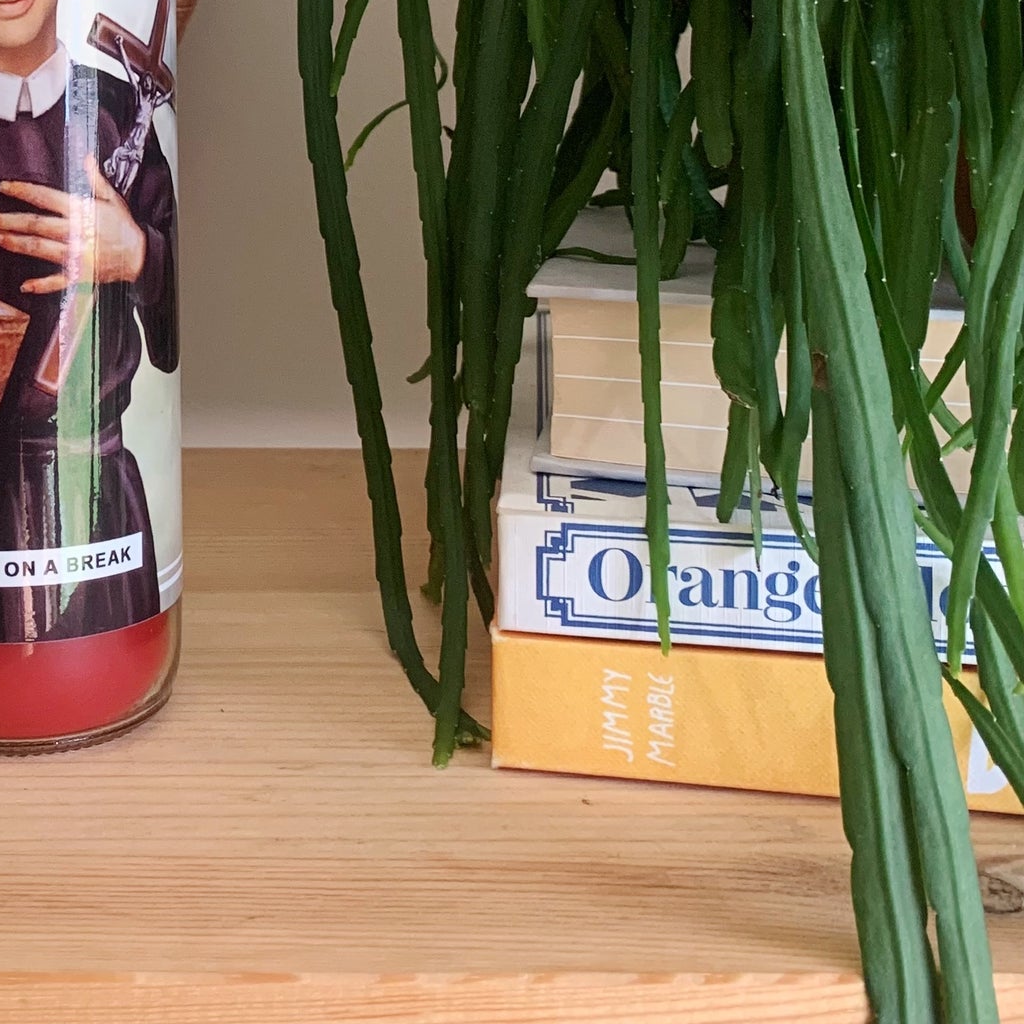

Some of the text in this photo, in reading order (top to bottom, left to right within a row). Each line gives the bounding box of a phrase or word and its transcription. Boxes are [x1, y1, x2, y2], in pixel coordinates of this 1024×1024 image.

[4, 560, 36, 578] ON
[43, 559, 59, 576] A
[66, 545, 133, 573] BREAK
[601, 668, 633, 763] JIMMY
[646, 671, 676, 767] MARBLE
